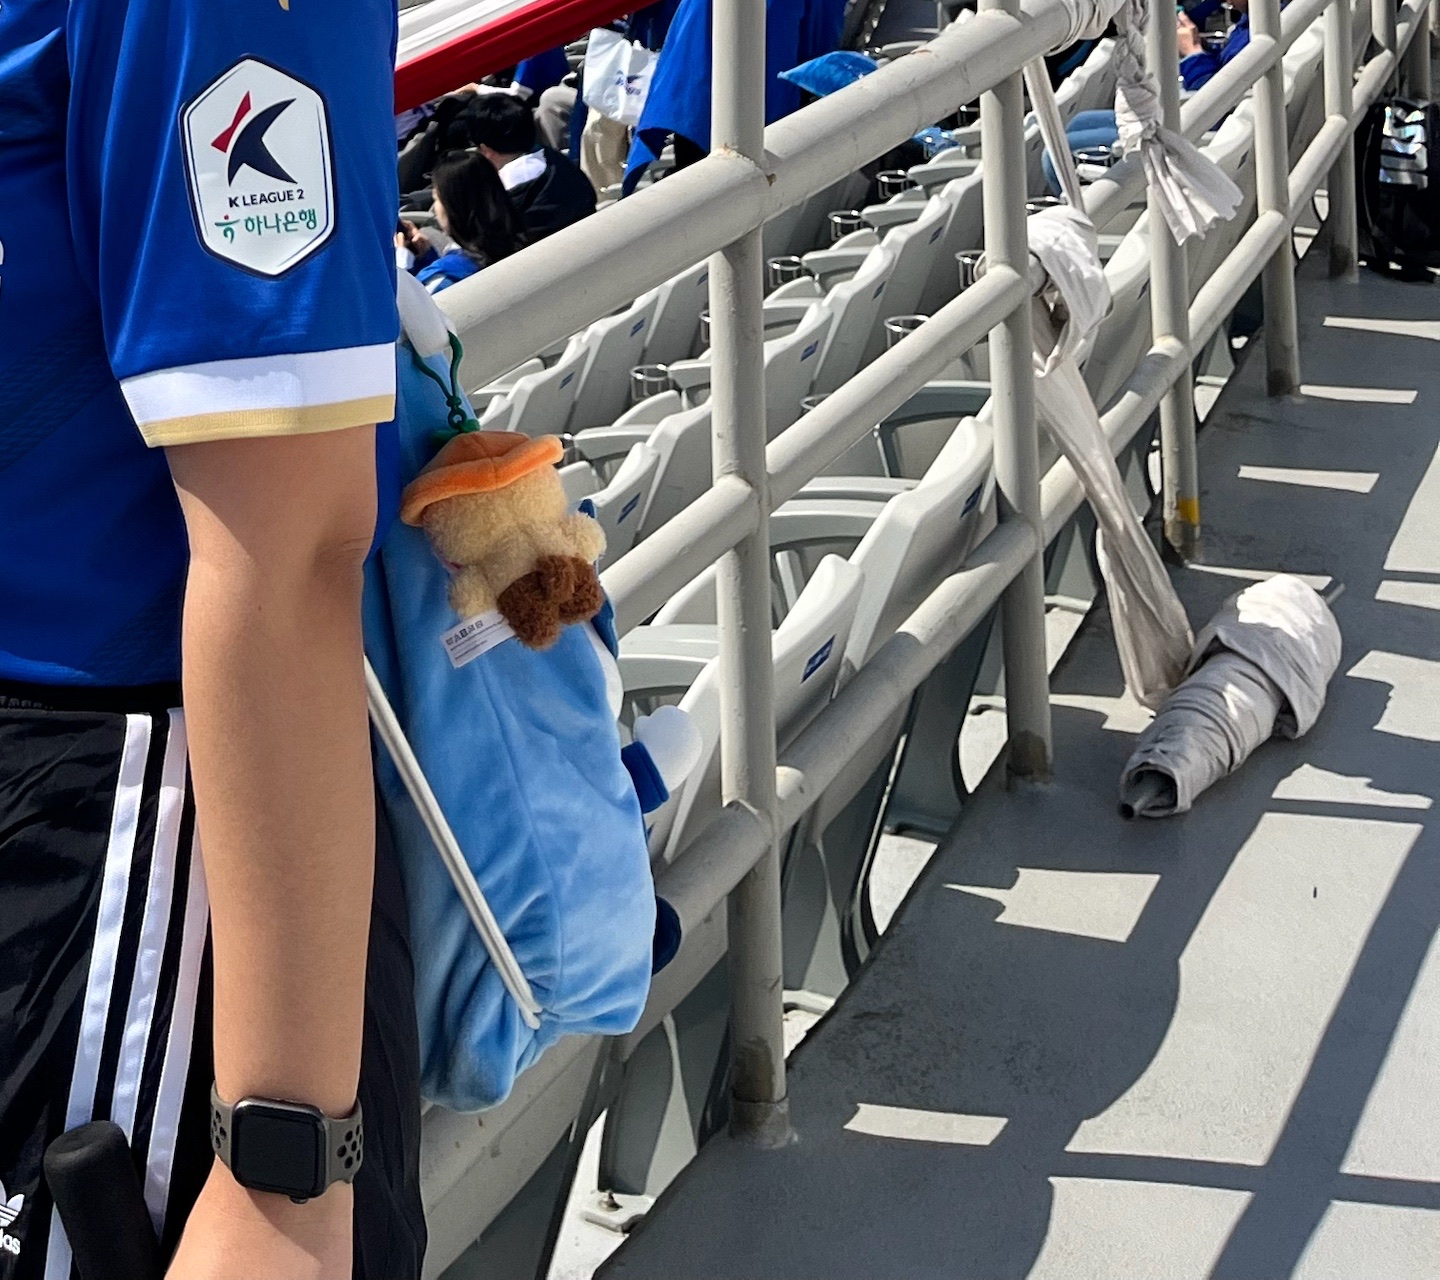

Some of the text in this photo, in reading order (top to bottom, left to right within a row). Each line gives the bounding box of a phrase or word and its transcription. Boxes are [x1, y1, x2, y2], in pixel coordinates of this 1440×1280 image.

[228, 188, 305, 208] K LEAGUE 2
[244, 208, 318, 236] 하나은행
